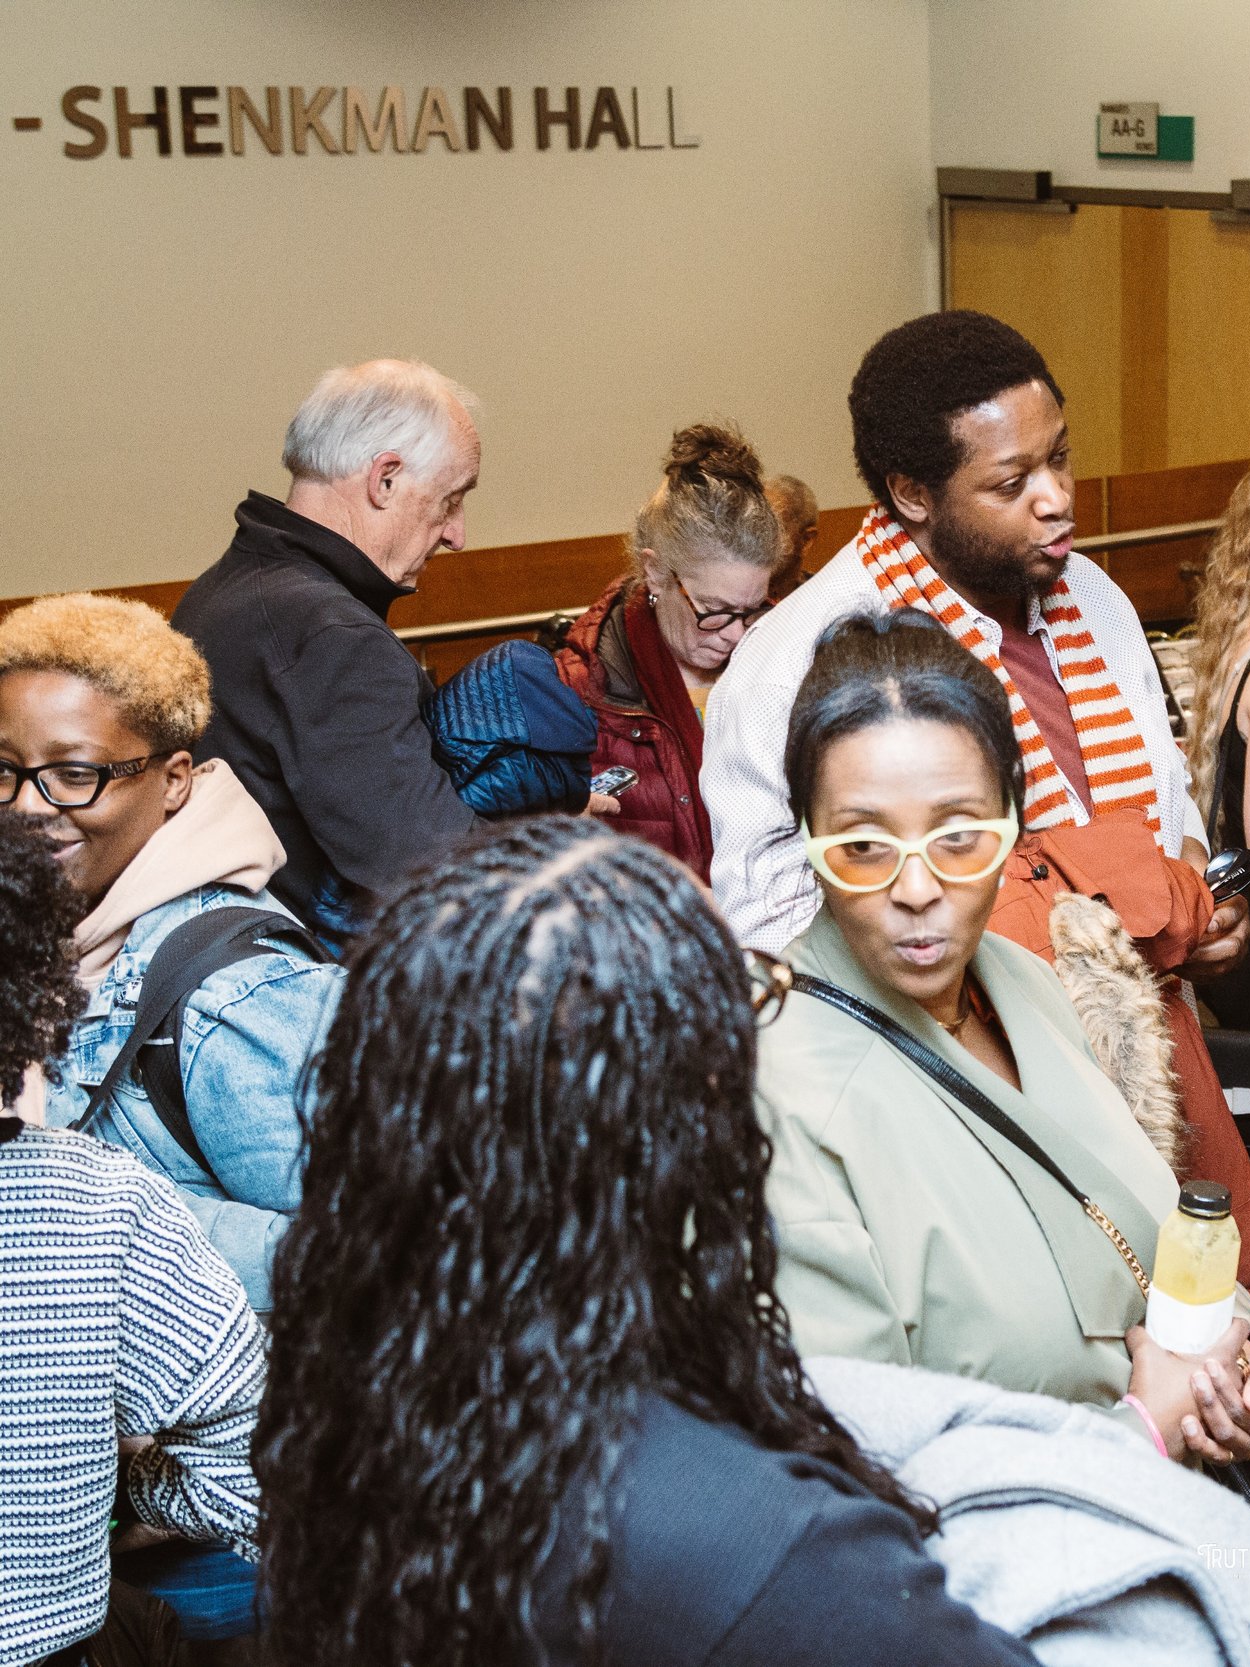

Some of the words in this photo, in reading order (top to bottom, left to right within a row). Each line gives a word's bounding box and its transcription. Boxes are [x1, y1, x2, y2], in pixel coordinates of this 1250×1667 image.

[60, 85, 514, 160] SHENKMAN
[533, 86, 700, 151] HALL
[1111, 118, 1146, 138] AA-G
